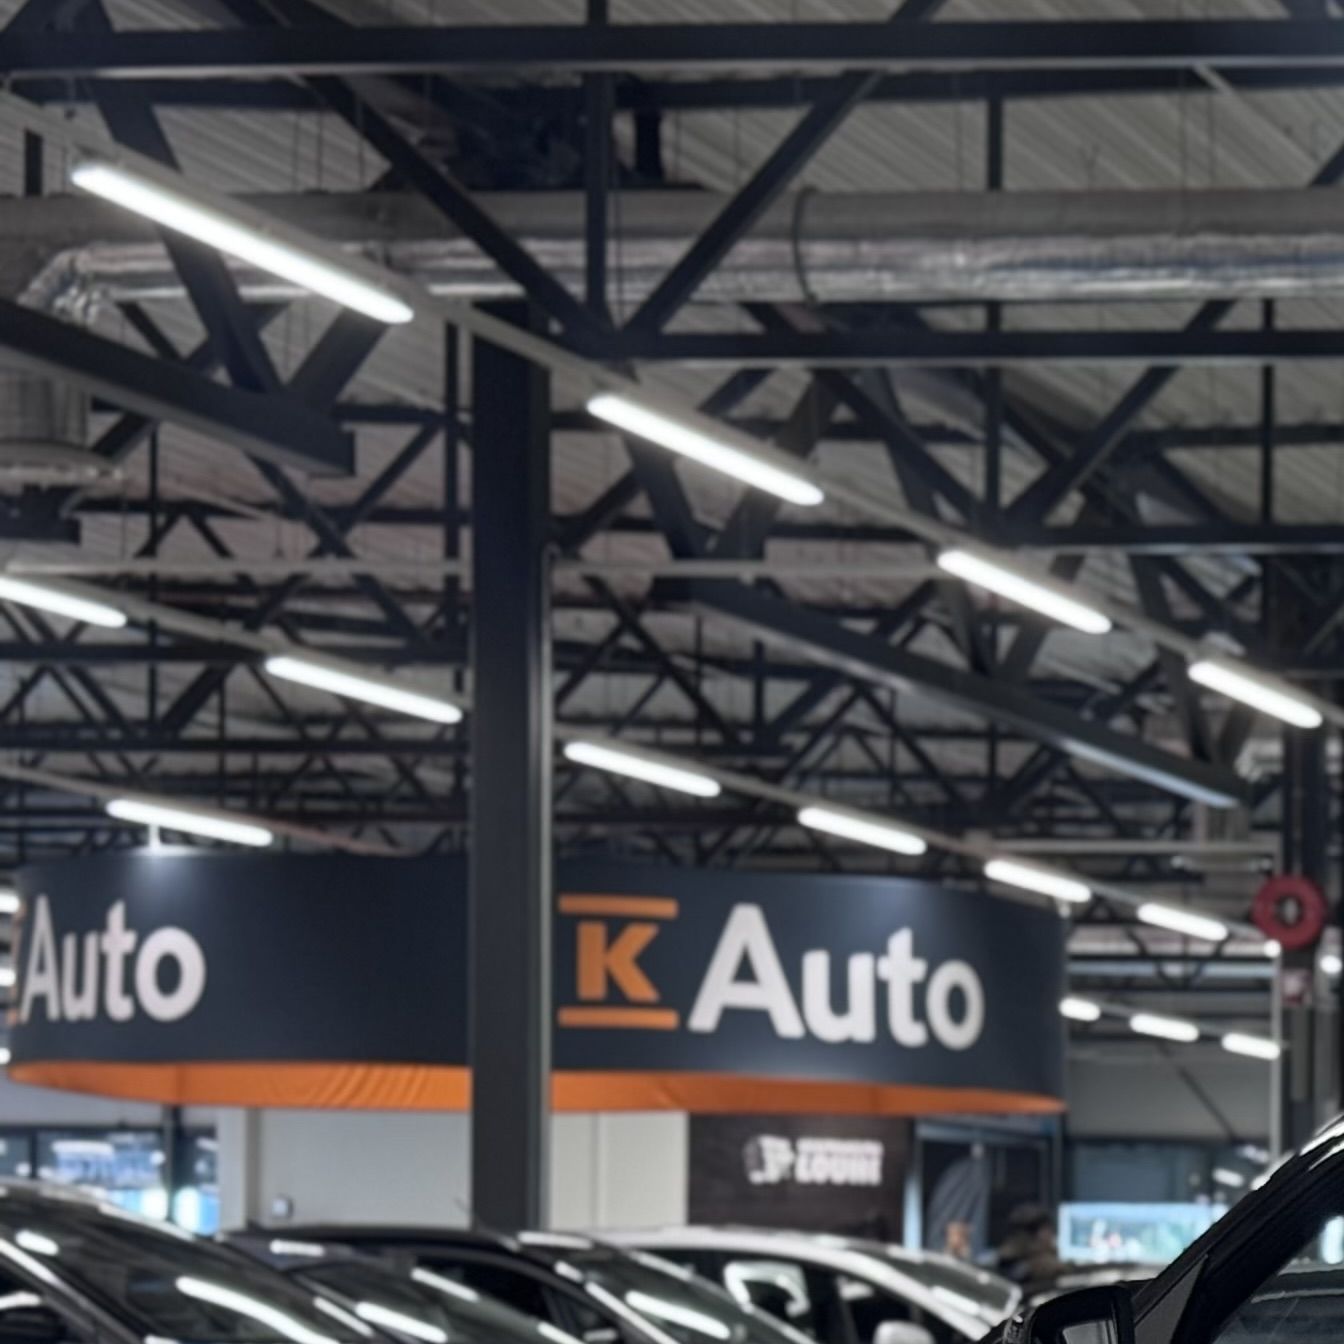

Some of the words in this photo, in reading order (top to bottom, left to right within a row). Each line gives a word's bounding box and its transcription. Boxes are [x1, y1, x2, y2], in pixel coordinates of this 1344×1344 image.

[20, 893, 206, 1022] Auto
[576, 922, 660, 1002] K
[687, 902, 985, 1050] Auto
